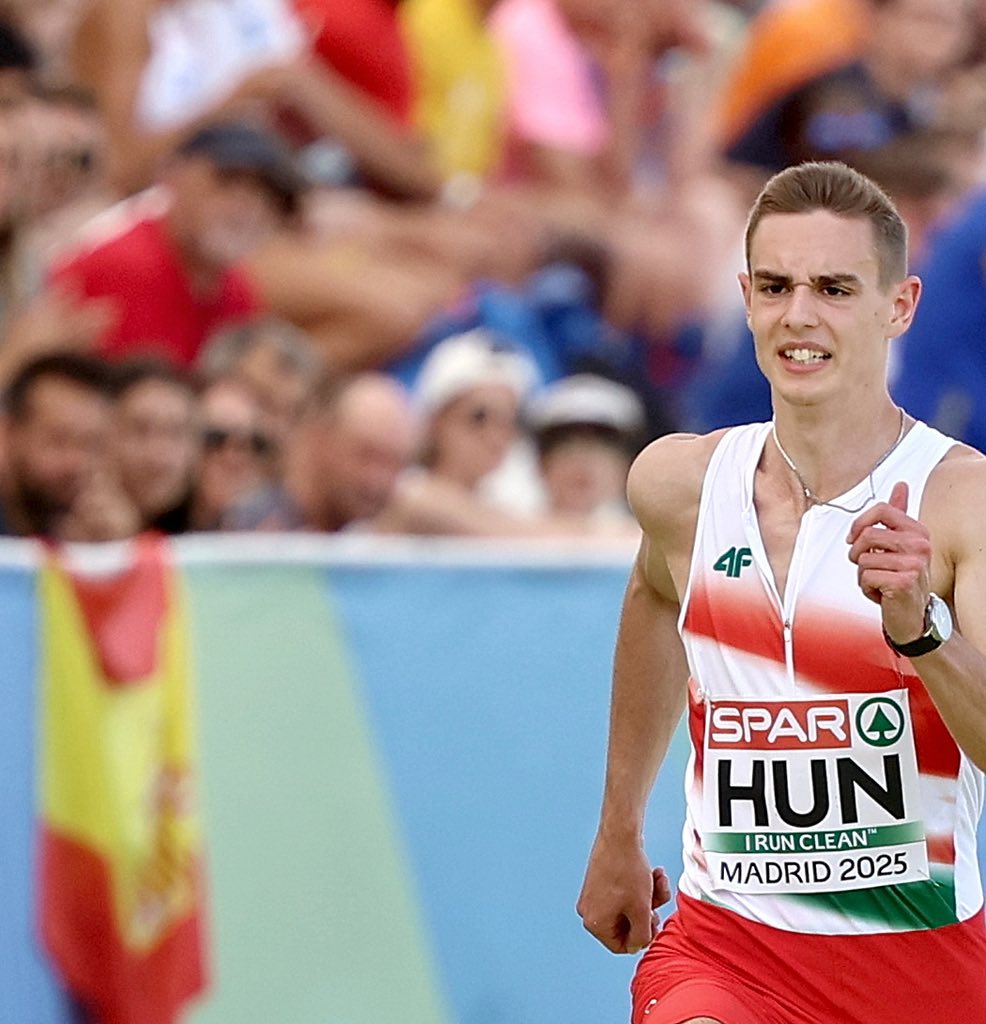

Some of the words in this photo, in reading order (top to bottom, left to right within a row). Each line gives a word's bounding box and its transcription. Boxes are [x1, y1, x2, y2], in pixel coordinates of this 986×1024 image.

[713, 546, 752, 578] 4F
[711, 706, 848, 744] SPAR
[717, 753, 906, 828] HUN
[745, 834, 751, 851] I
[755, 834, 795, 851] RUN
[720, 861, 831, 884] MADRID
[839, 852, 908, 881] 2025
